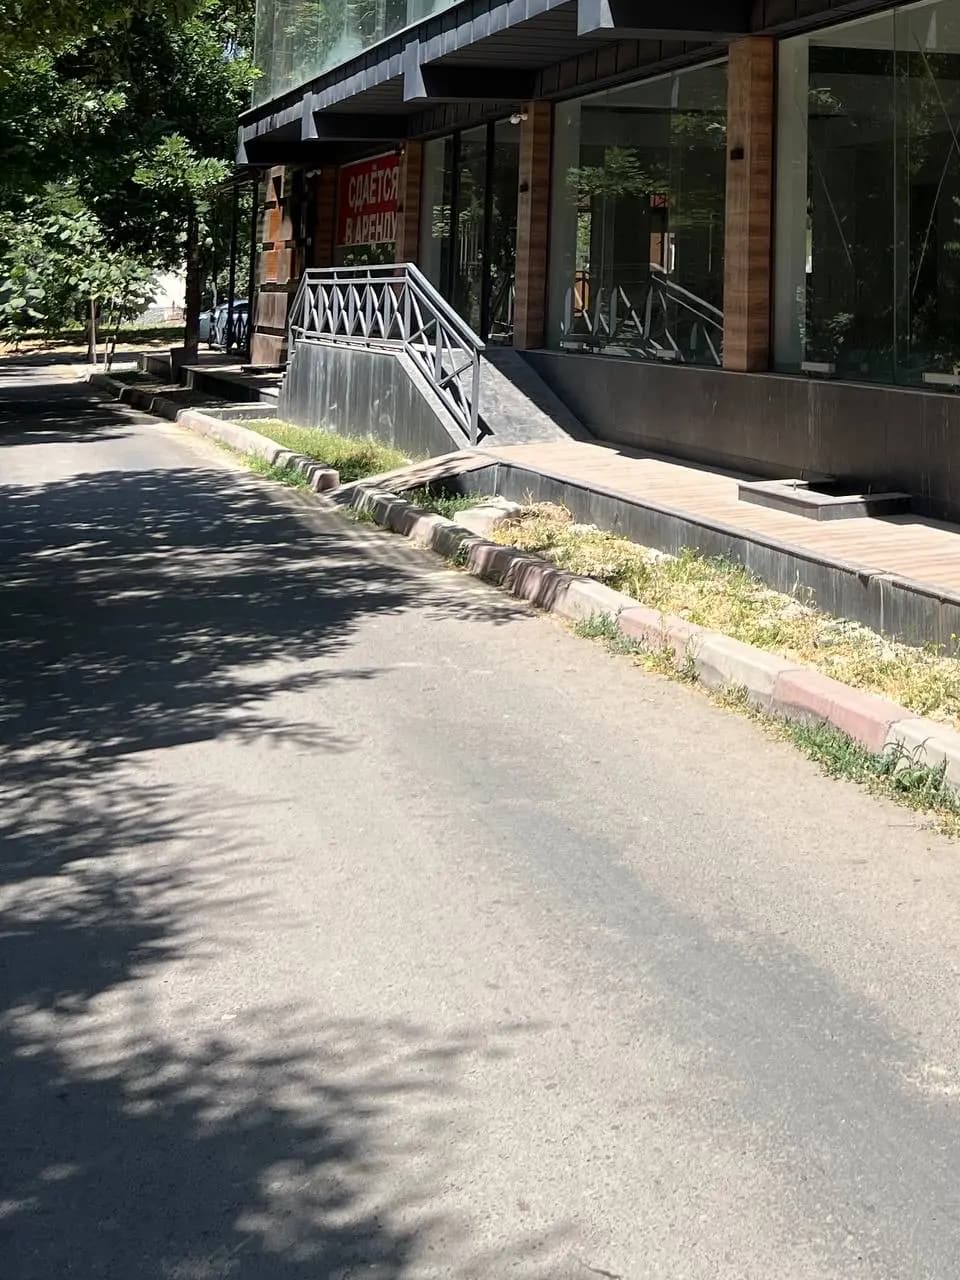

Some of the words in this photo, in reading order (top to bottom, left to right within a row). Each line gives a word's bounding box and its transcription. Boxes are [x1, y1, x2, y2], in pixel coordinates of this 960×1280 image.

[348, 164, 399, 213] СДАЁТСЯ
[345, 218, 353, 244] В
[355, 211, 397, 243] АРЕНДУ
